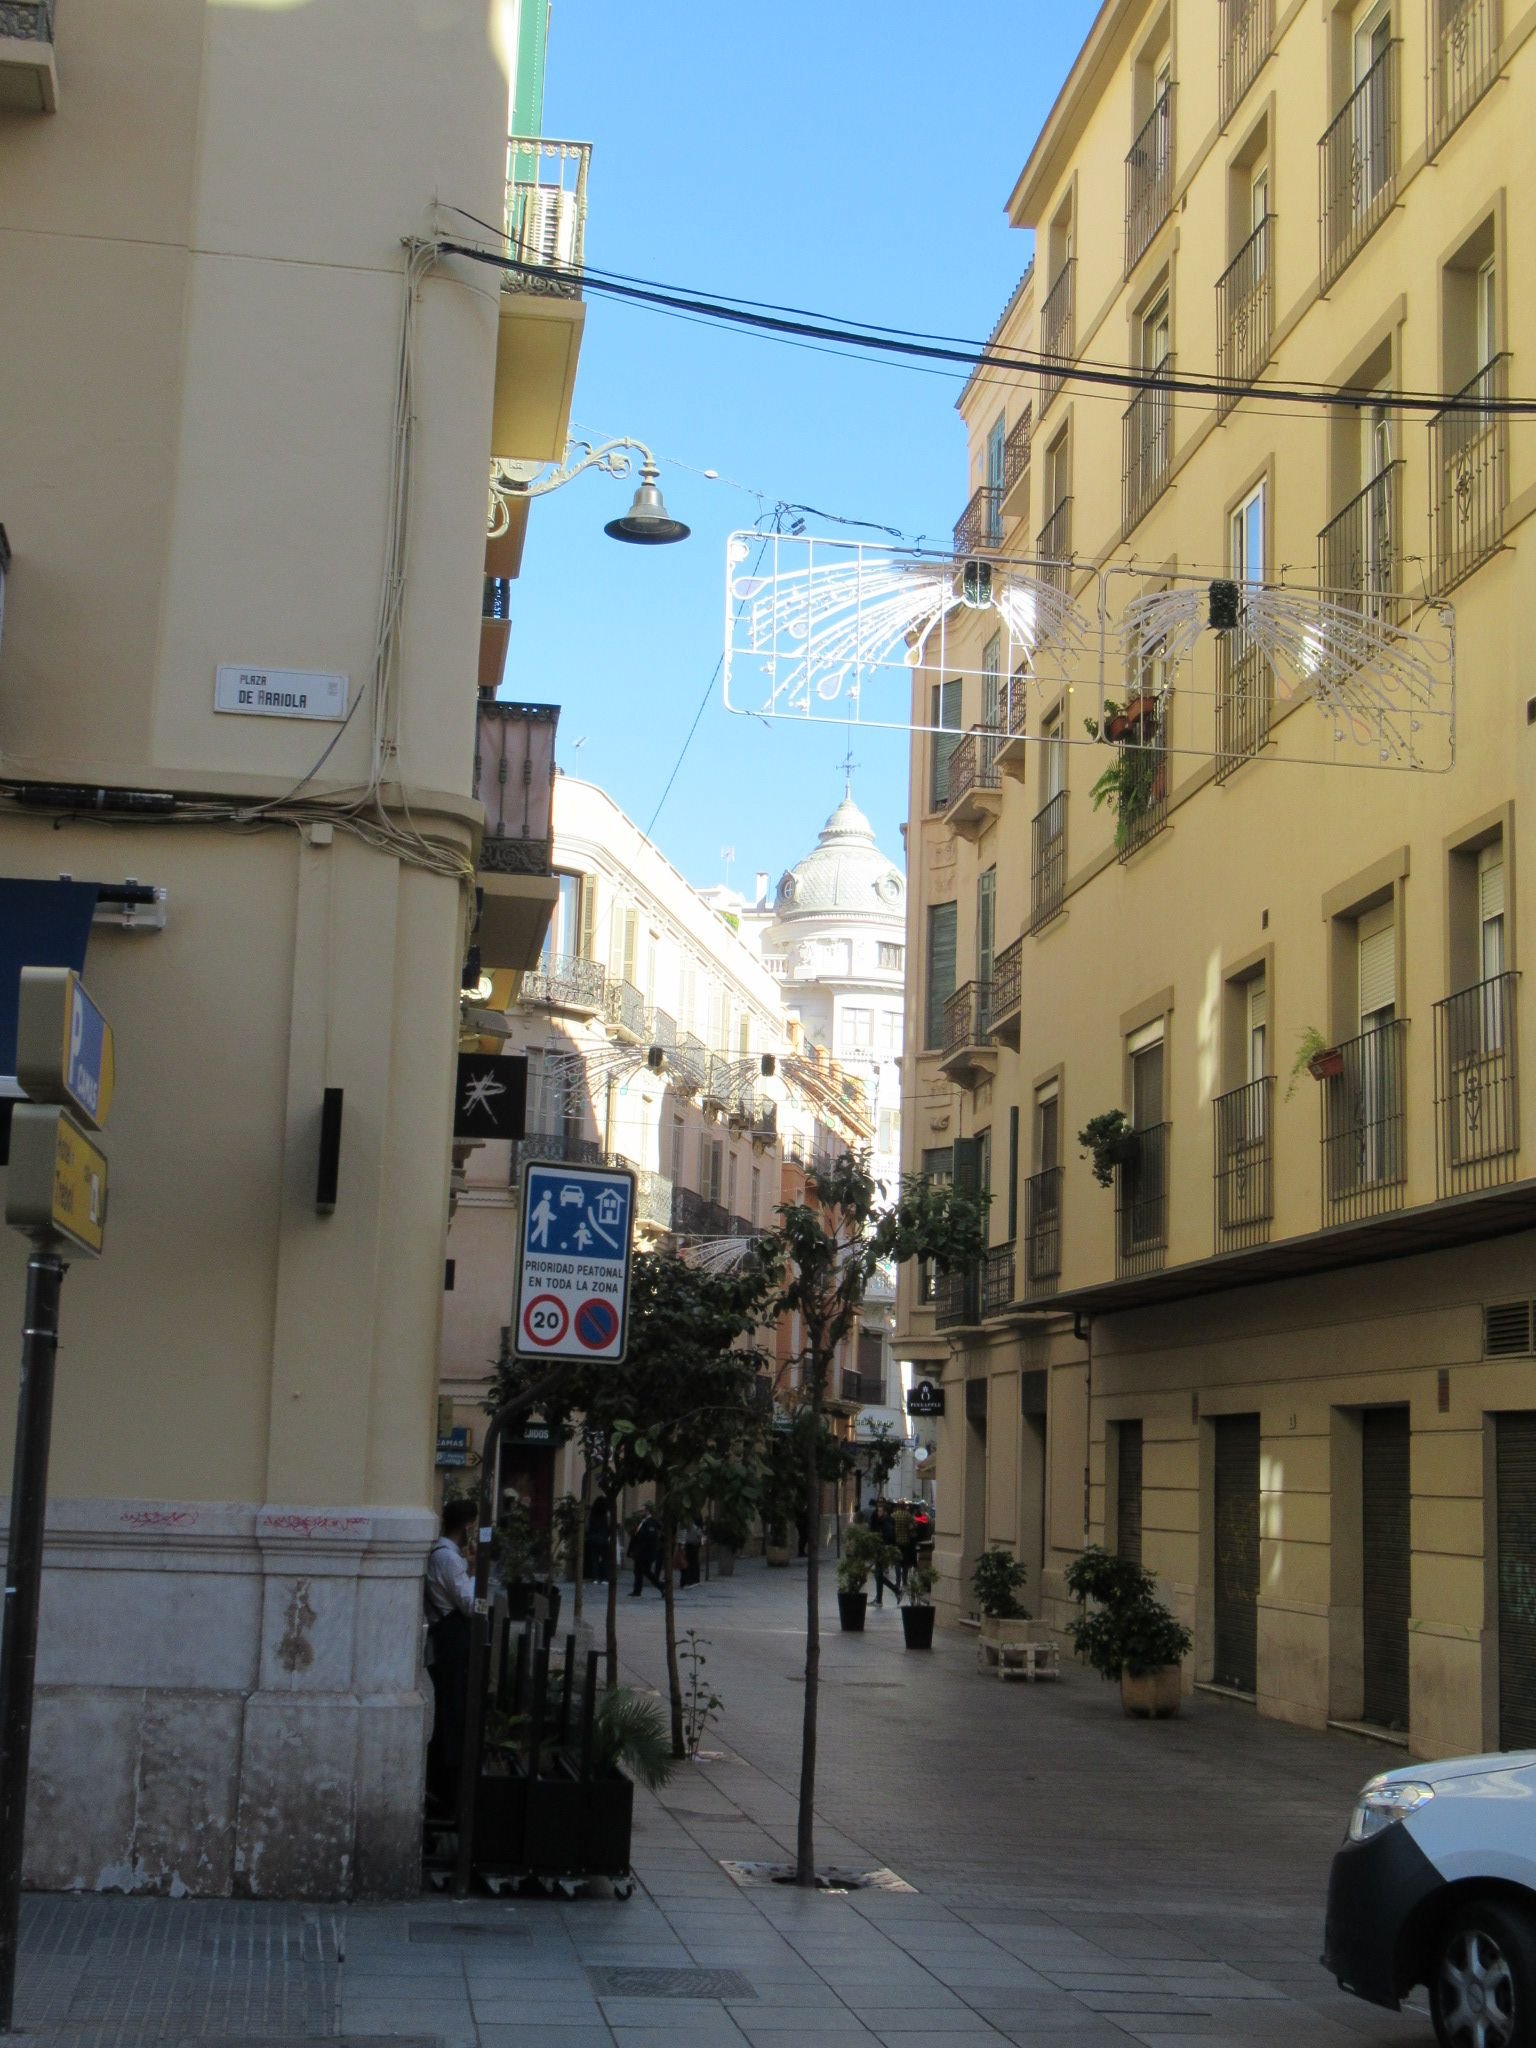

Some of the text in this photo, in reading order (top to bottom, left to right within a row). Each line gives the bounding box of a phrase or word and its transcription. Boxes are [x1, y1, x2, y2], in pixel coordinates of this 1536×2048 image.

[240, 674, 266, 686] PLAZA
[239, 690, 254, 704] DE
[525, 1260, 624, 1279] PRIORIDAD PEATONAL
[528, 1276, 619, 1294] EN TODA LA ZONA
[533, 1311, 560, 1329] 20
